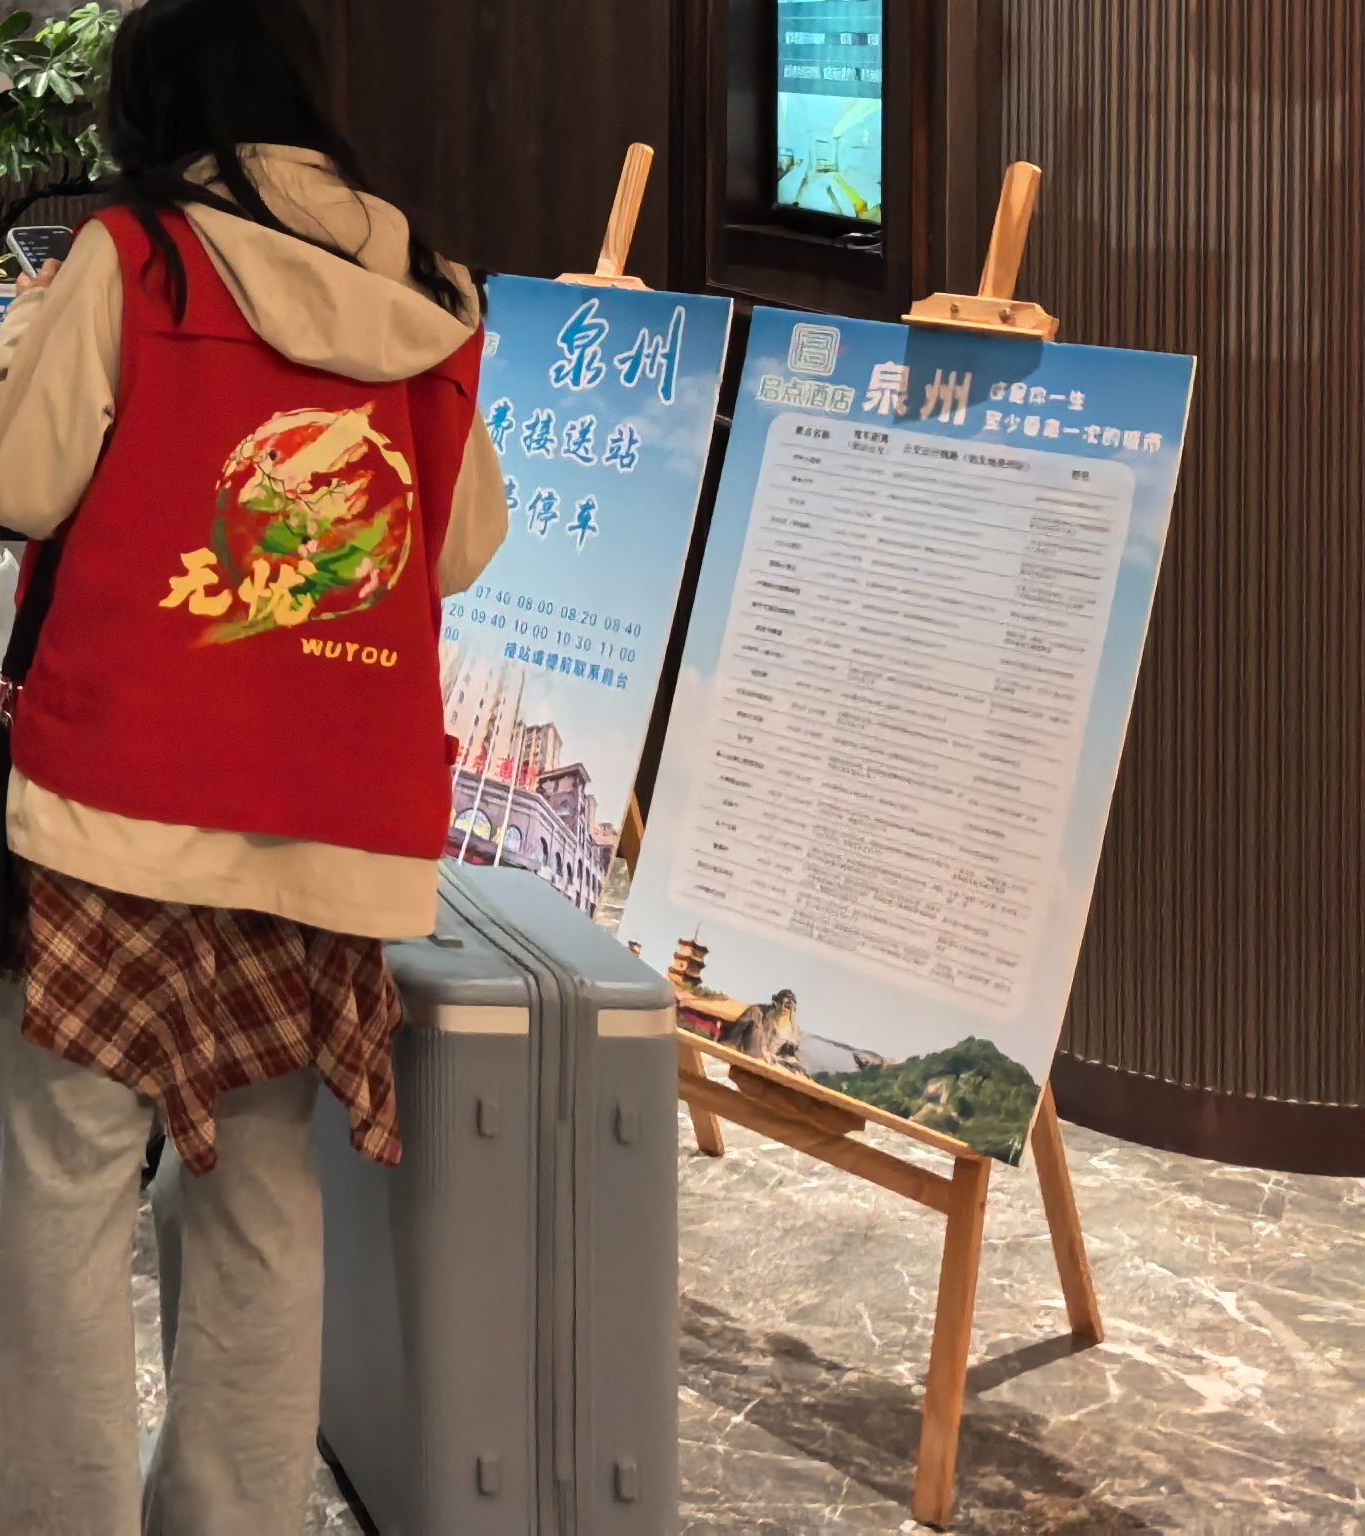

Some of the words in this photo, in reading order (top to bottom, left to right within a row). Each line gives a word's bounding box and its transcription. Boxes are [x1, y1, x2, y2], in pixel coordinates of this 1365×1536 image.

[550, 298, 685, 405] 泉州
[862, 361, 972, 426] 泉州
[158, 547, 316, 627] 无忧
[301, 638, 398, 667] WUYOU
